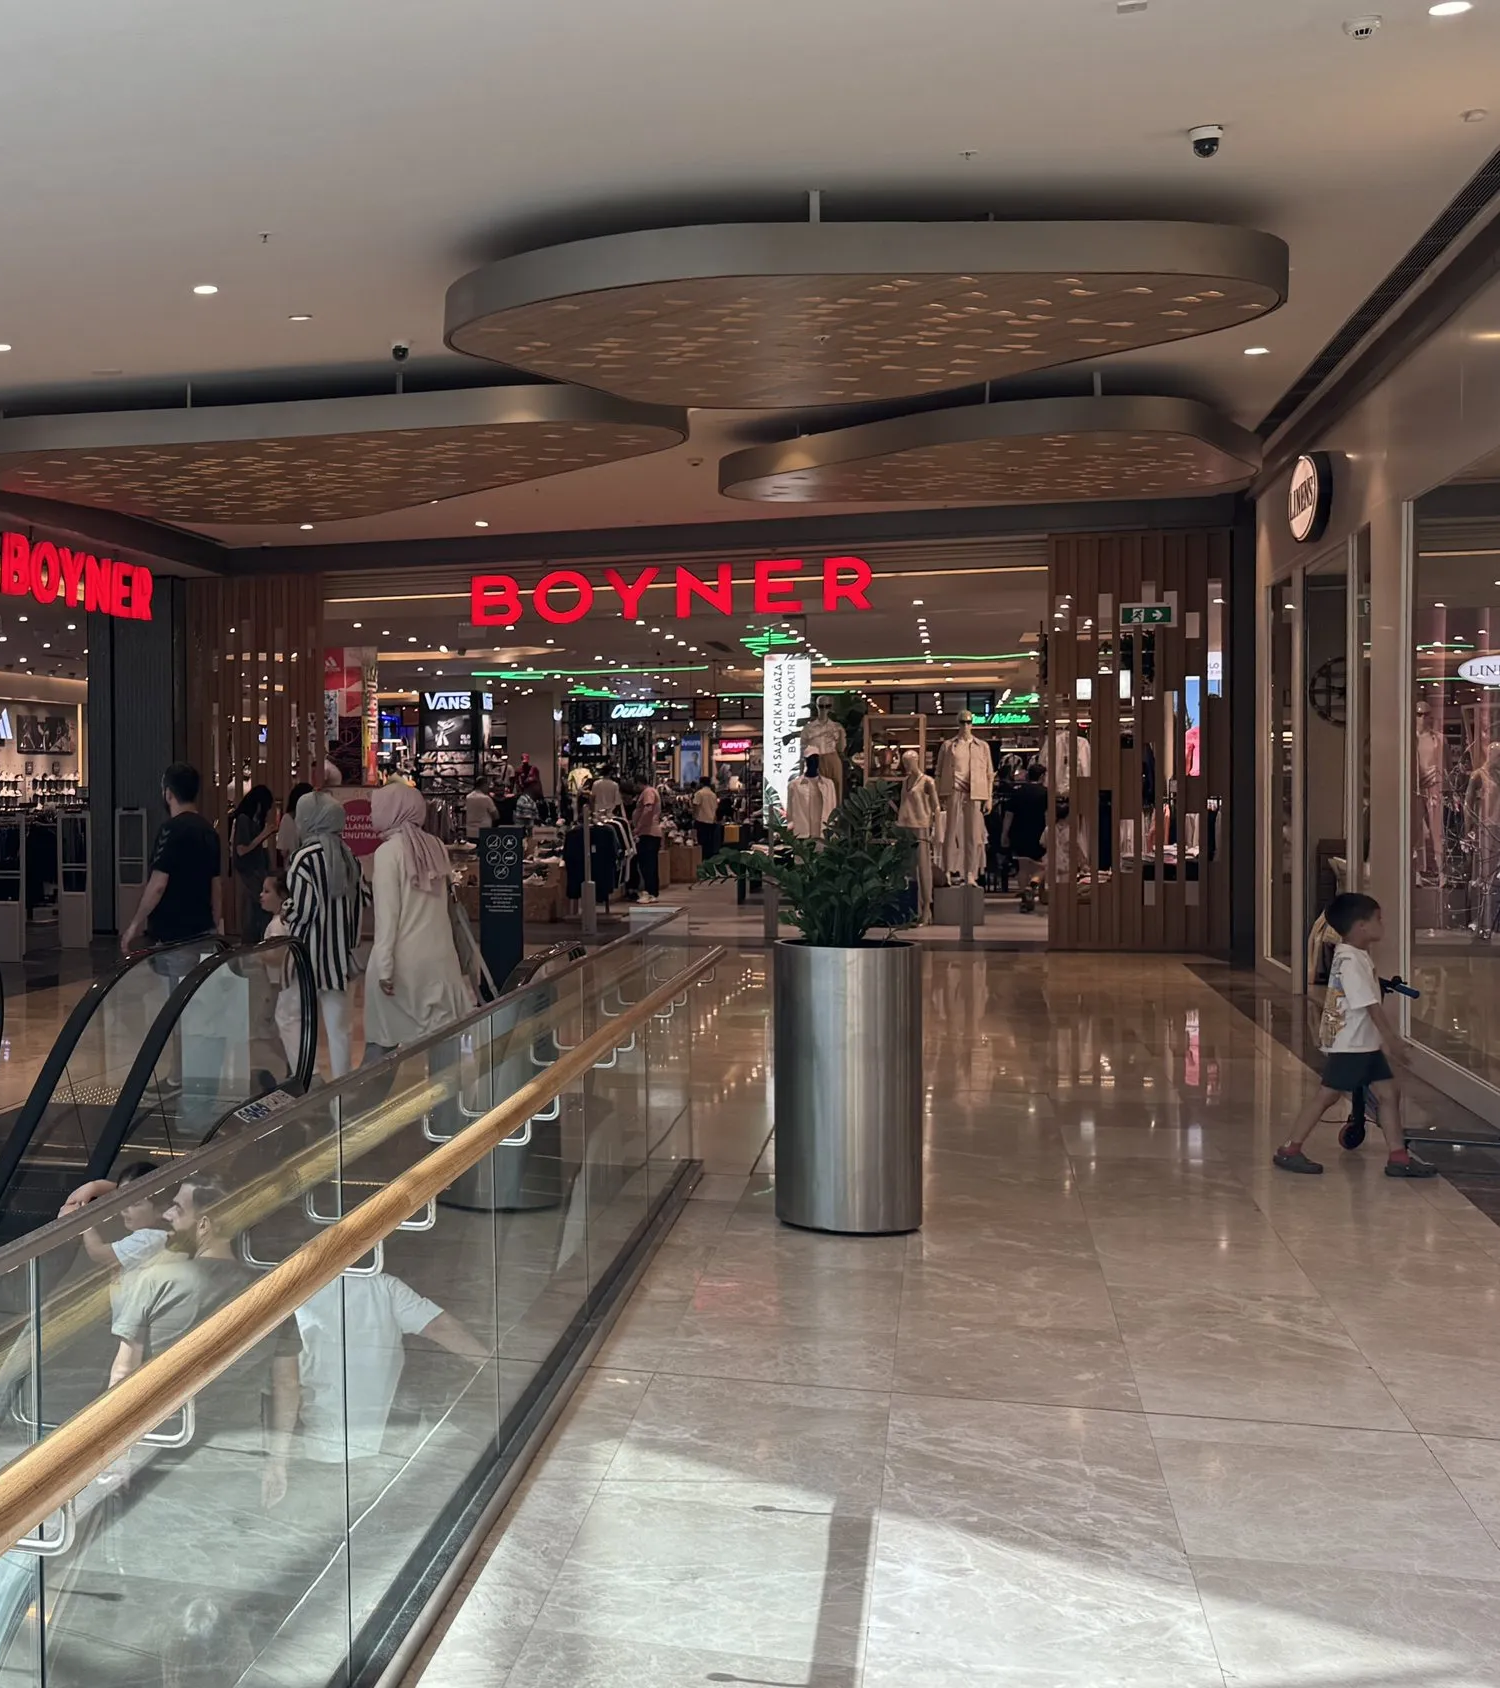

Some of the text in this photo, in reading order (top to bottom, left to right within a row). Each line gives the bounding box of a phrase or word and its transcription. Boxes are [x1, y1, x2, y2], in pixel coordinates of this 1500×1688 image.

[1288, 475, 1314, 521] LINENS
[1, 533, 153, 621] BOYNER
[471, 557, 873, 627] BOYNER
[1469, 665, 1500, 676] LIN
[424, 691, 471, 710] VANS
[772, 664, 785, 773] 24 SAAT AÇIK MAĞAZA
